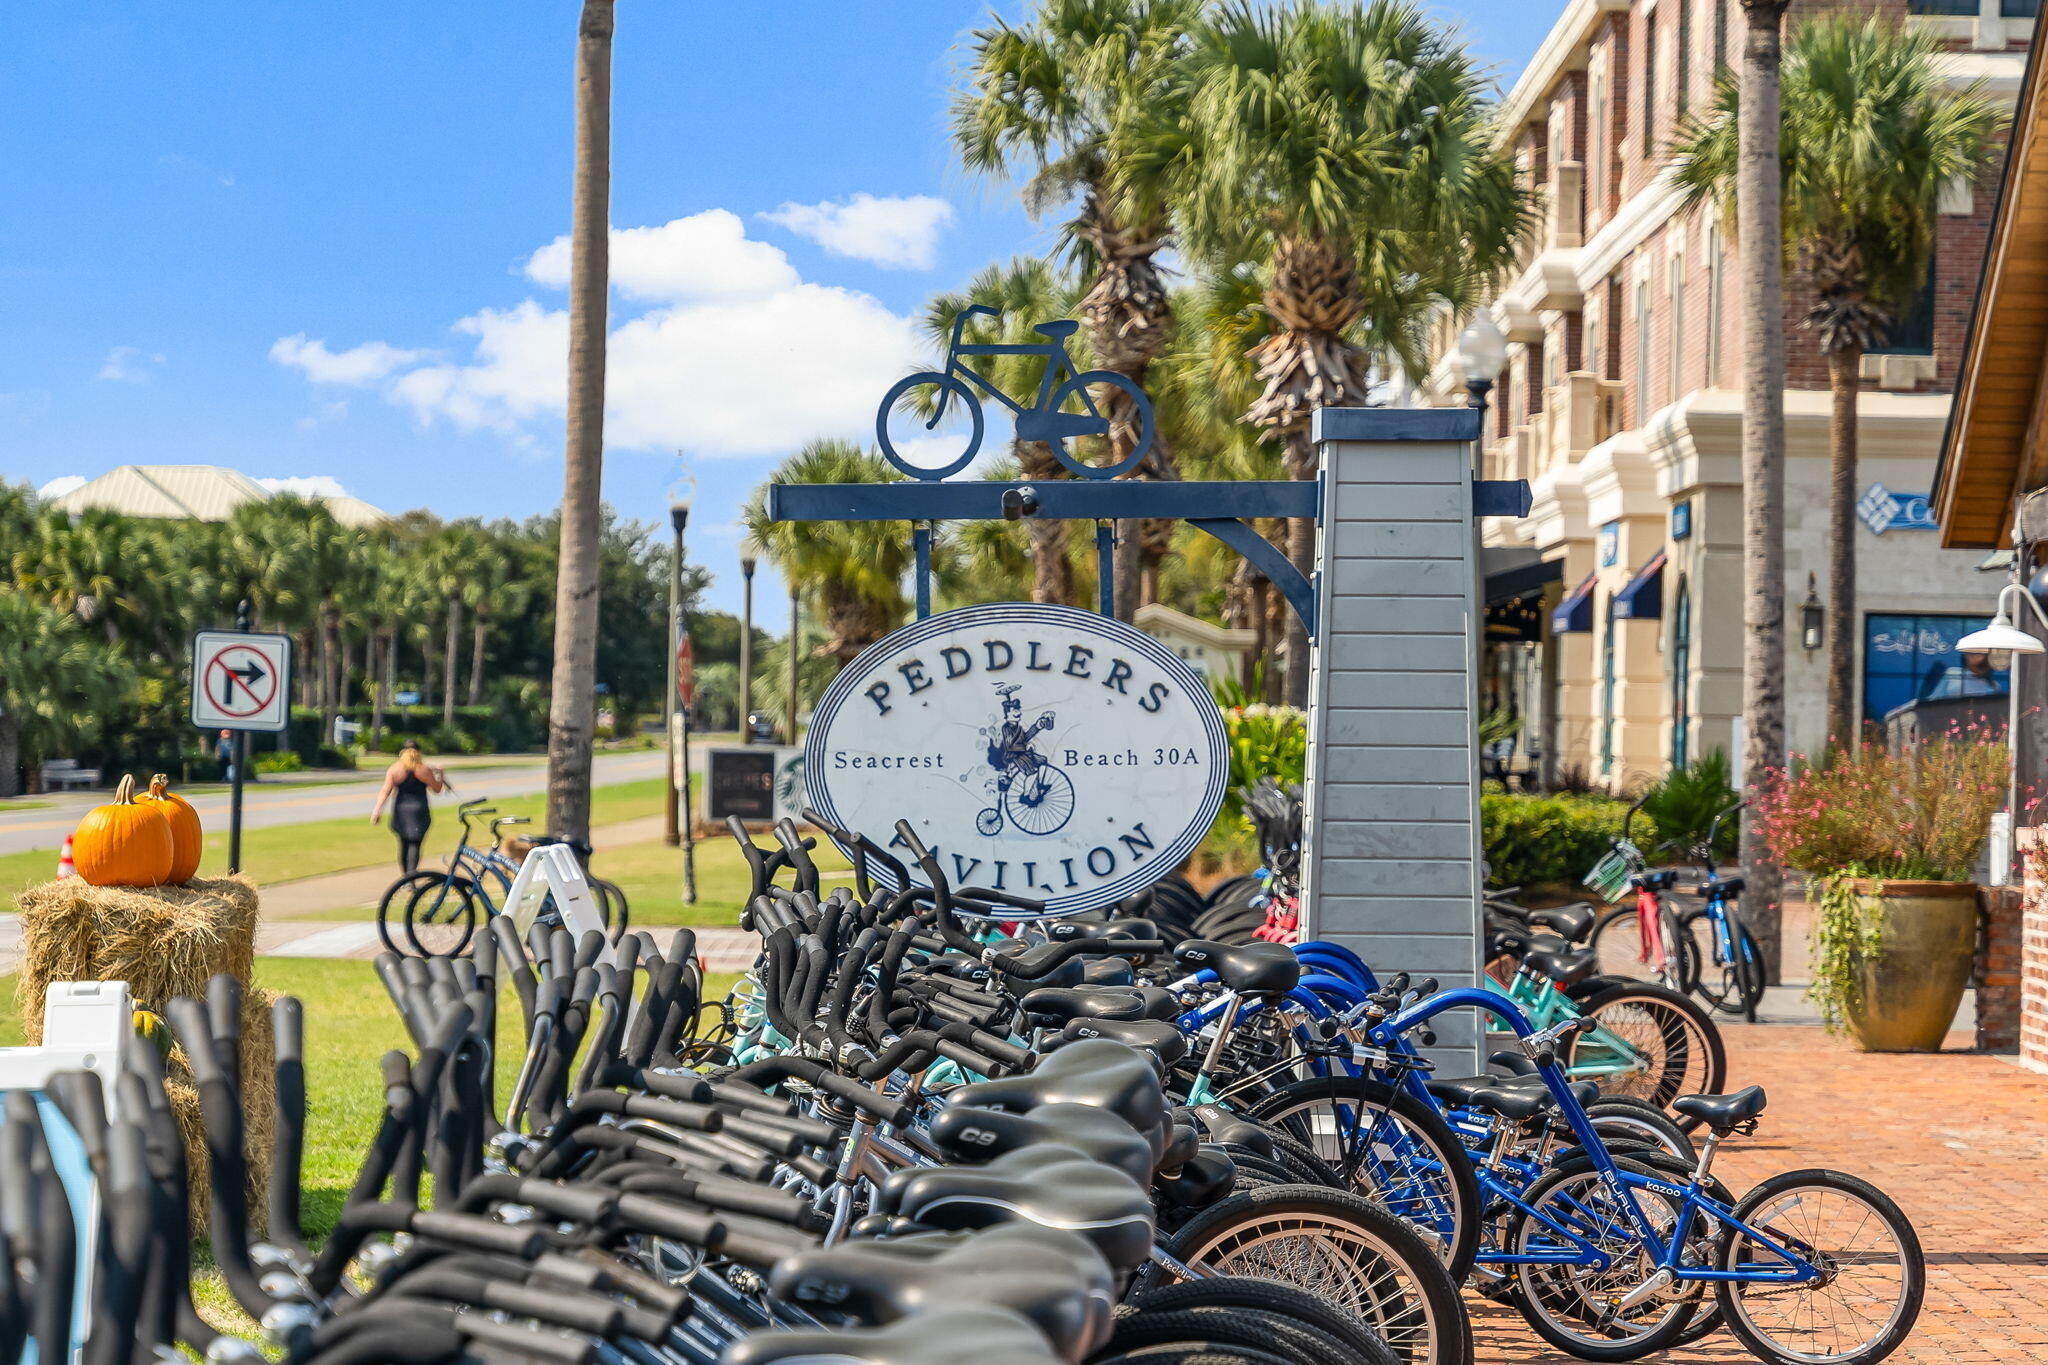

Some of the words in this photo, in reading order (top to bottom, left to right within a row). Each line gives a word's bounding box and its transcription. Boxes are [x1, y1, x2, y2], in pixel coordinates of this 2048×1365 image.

[864, 640, 1169, 716] PEDDLERS
[834, 751, 944, 769] Seacrest
[1063, 749, 1139, 766] Beach
[1153, 747, 1199, 766] 30A
[1055, 926, 1075, 934] C9
[1185, 950, 1207, 961] C9
[1078, 1027, 1100, 1039] C9
[958, 1127, 998, 1146] C9
[1401, 1153, 1443, 1221] BURLEY
[1645, 1180, 1681, 1197] kazoo
[1604, 1170, 1648, 1239] BURLEY
